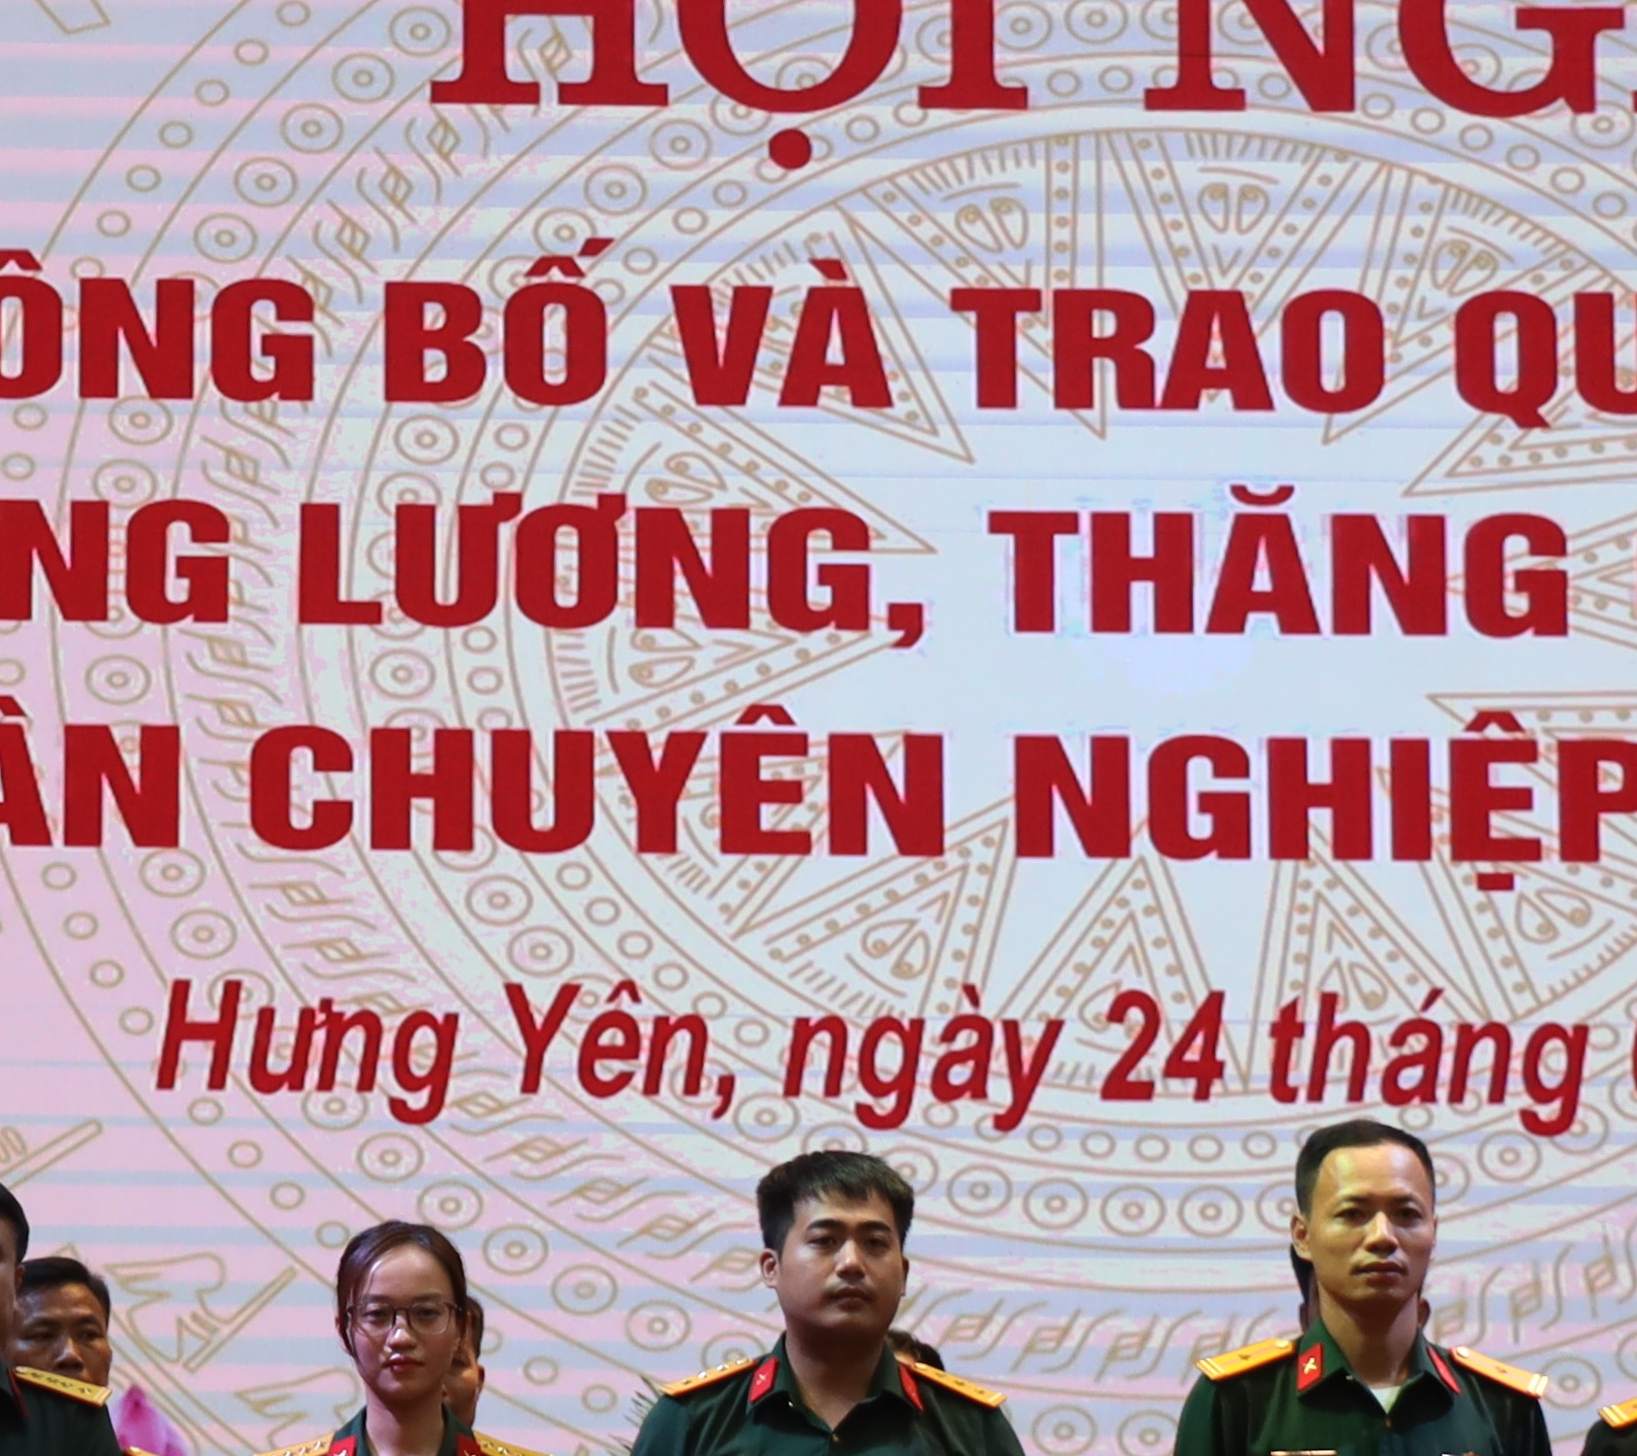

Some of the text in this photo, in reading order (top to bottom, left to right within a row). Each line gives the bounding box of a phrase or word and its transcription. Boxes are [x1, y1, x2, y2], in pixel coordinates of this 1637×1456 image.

[384, 238, 612, 406] BỐ
[672, 260, 891, 408] VÀ
[951, 288, 1384, 413] TRAO
[299, 492, 923, 647] LƯƠNG,
[990, 487, 1568, 637] THĂNG
[250, 704, 944, 857] CHUYÊN
[158, 980, 458, 1125] Hưng
[507, 981, 734, 1117] Yên,
[785, 985, 1062, 1131] ngày
[1101, 991, 1224, 1100] 24
[1271, 990, 1589, 1136] tháng
